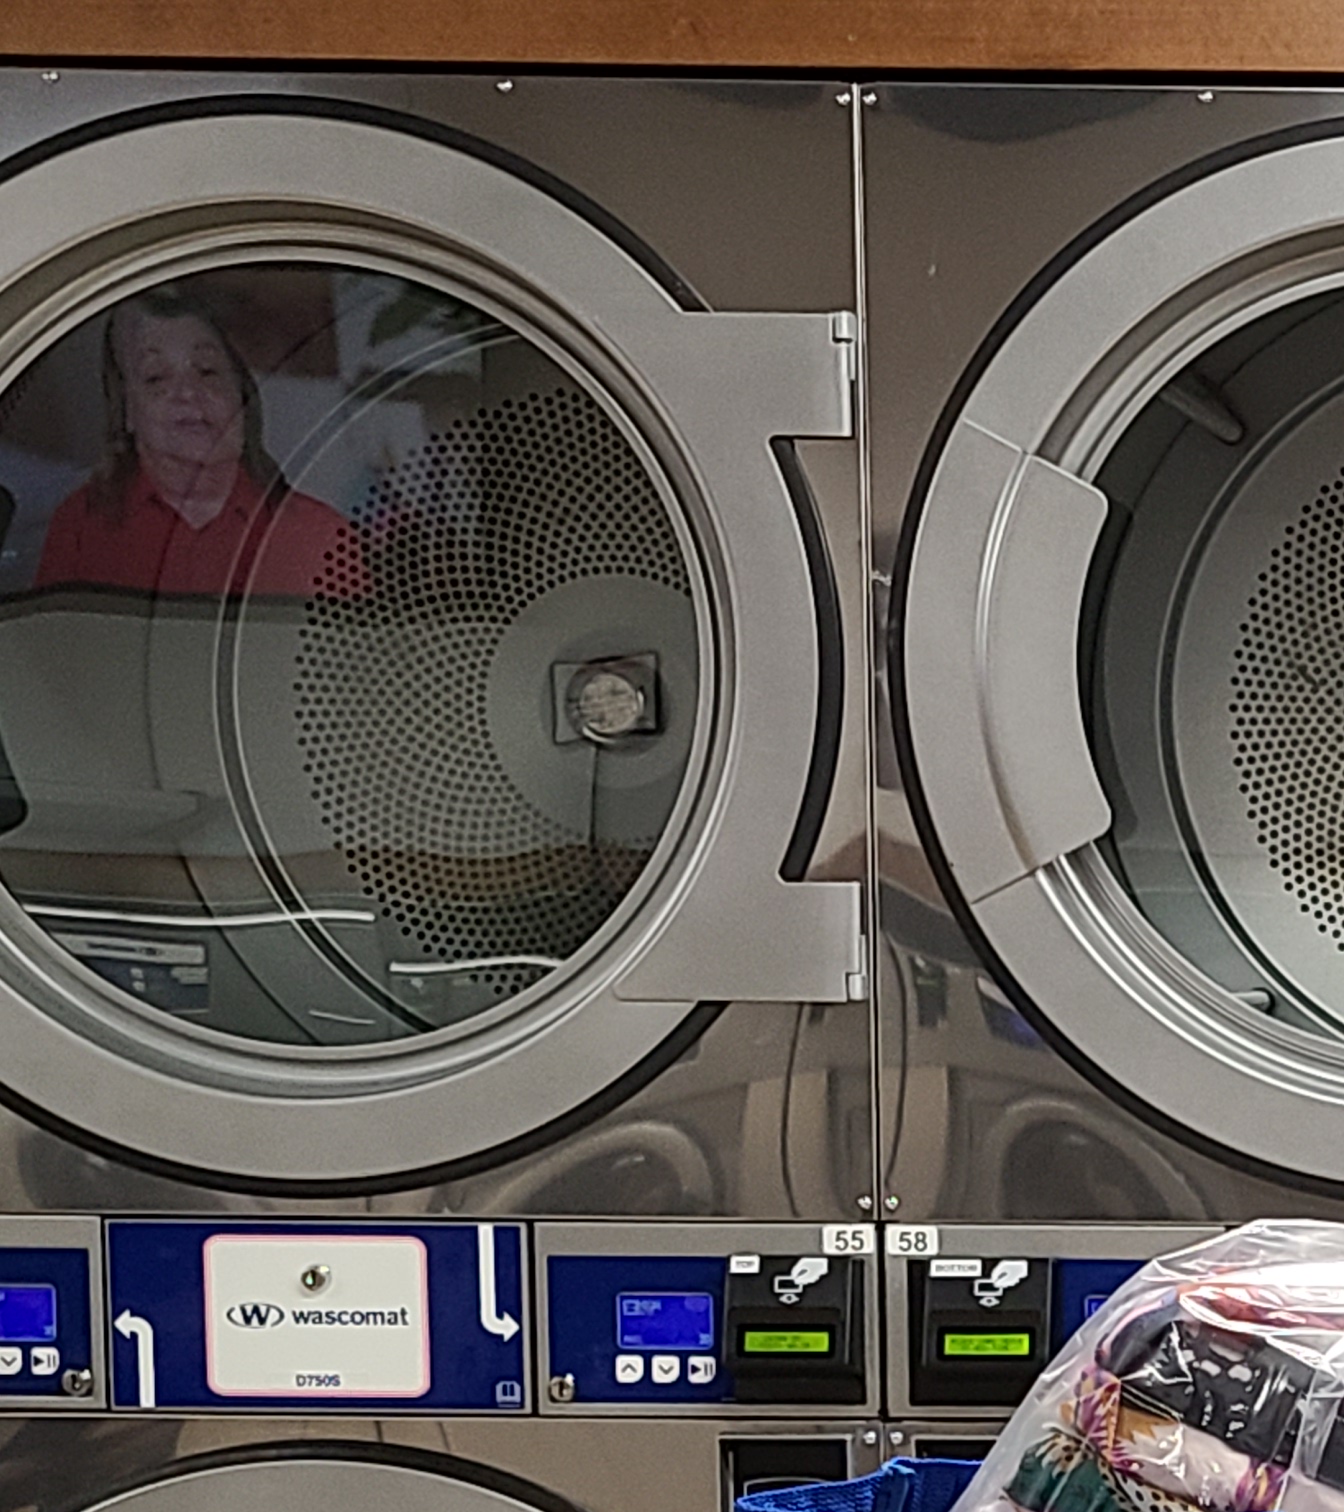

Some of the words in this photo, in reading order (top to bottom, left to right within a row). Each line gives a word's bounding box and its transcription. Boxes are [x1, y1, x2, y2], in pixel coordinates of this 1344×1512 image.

[836, 1230, 864, 1251] 55
[899, 1231, 928, 1252] 58
[291, 1307, 409, 1326] wascomat
[295, 1374, 341, 1387] D750S
